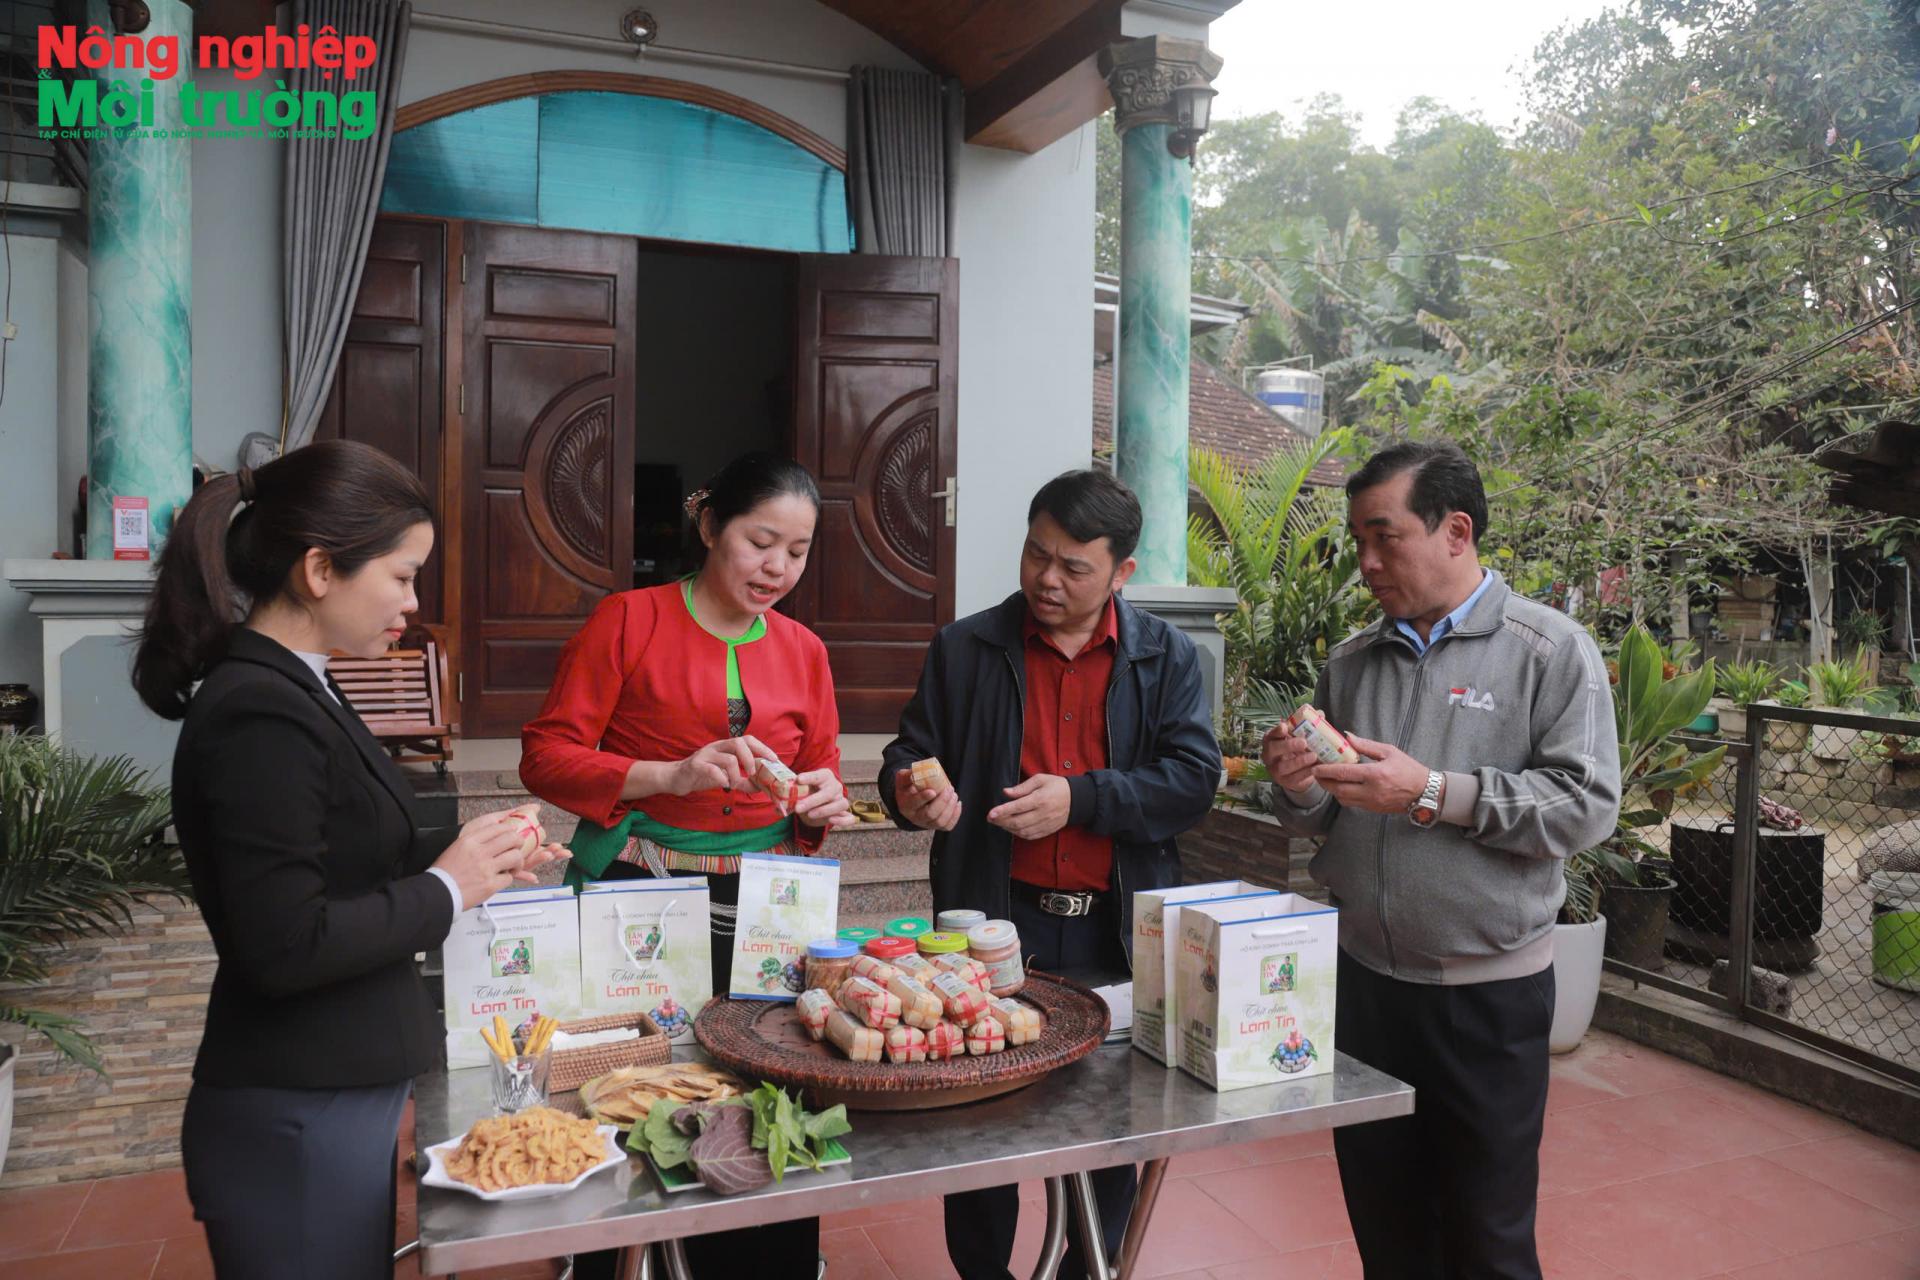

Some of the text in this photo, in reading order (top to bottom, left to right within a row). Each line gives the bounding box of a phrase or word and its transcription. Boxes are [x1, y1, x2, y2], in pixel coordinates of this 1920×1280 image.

[1449, 687, 1495, 712] FILA
[778, 942, 799, 955] Tin
[645, 982, 669, 995] Tin
[512, 997, 536, 1010] Tin
[1275, 1015, 1296, 1029] Tin
